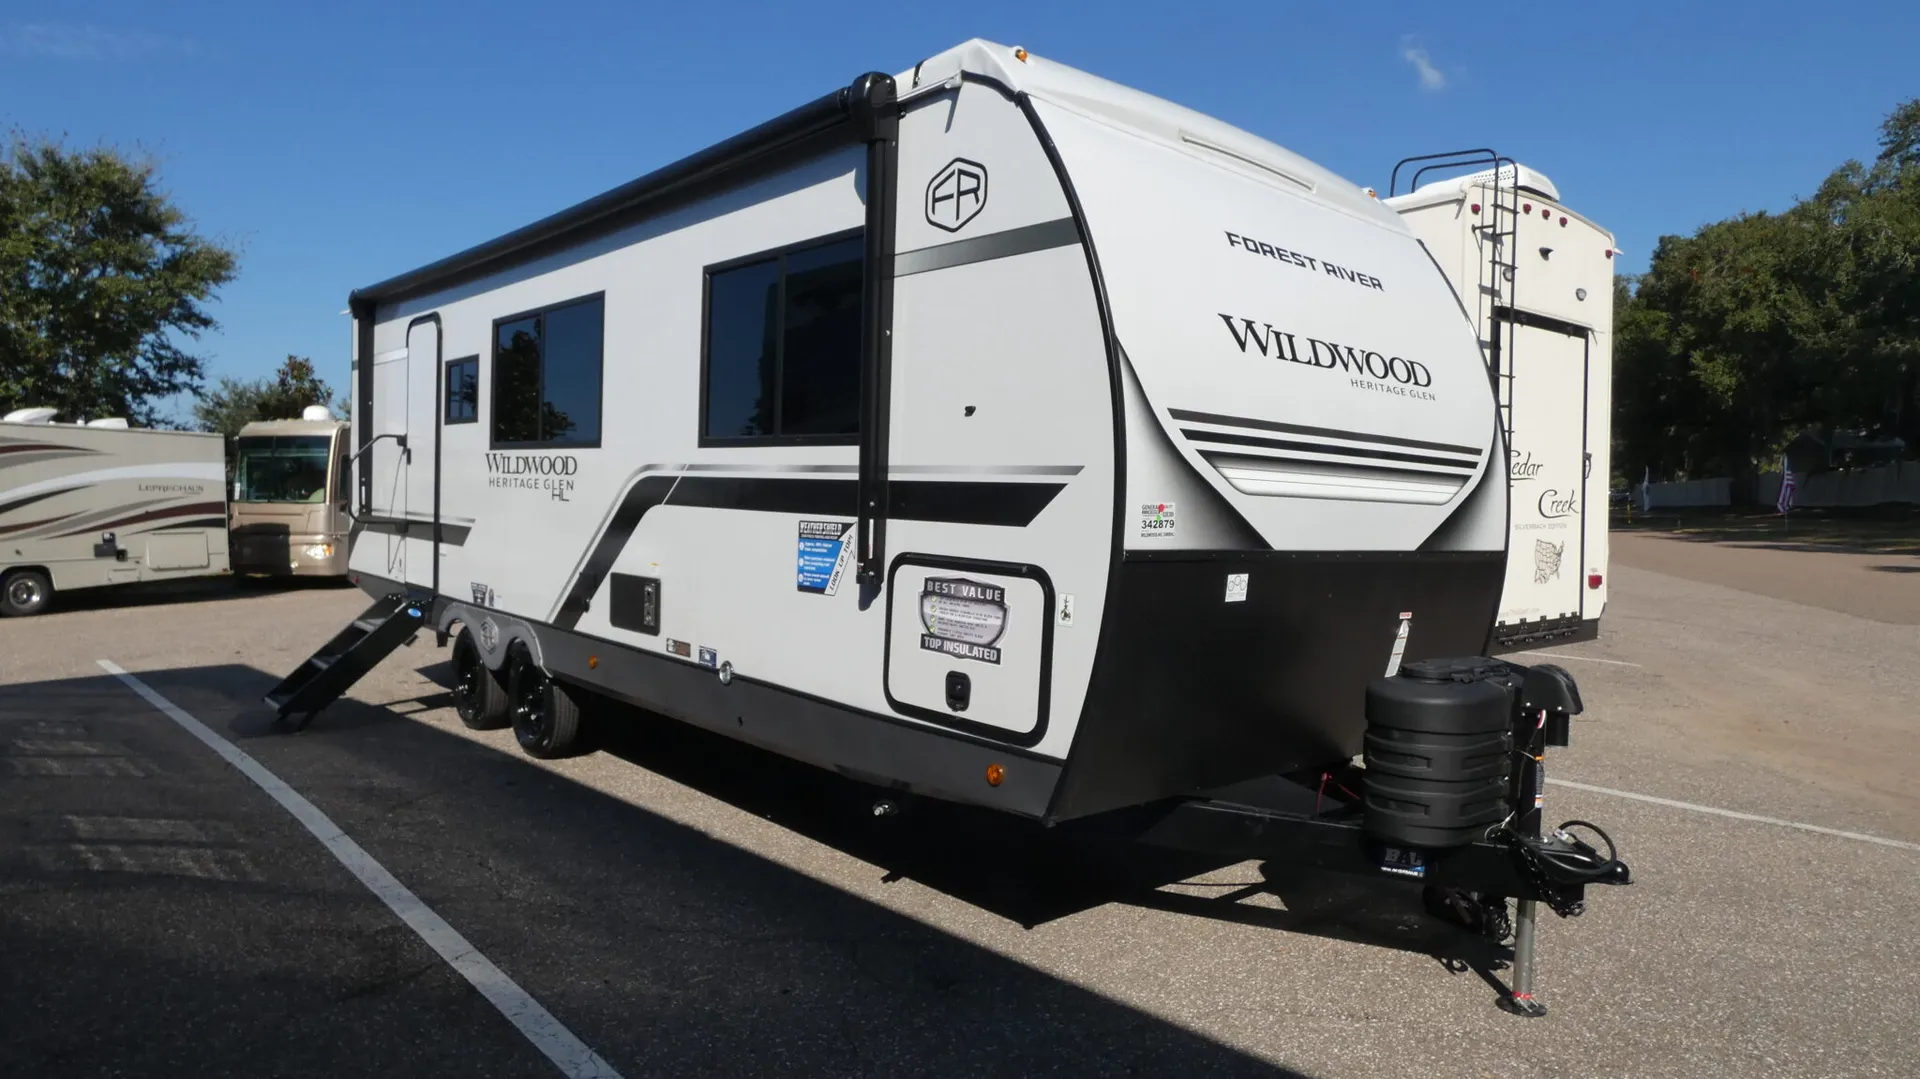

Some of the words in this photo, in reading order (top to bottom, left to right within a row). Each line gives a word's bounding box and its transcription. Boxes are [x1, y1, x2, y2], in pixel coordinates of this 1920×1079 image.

[1225, 231, 1317, 271] FOREST
[1321, 260, 1385, 292] RIVER
[1218, 313, 1432, 388] WILDWOOD
[1351, 378, 1407, 397] HERITAGE
[1409, 389, 1436, 401] GLEN
[485, 452, 578, 476] WILDWOOD
[489, 477, 540, 489] HERITAGE
[543, 479, 574, 490] GLEN
[1538, 489, 1580, 519] Creek
[1141, 520, 1175, 529] 342879
[829, 570, 840, 591] LOOK
[838, 555, 844, 568] UP
[927, 580, 956, 594] BEST
[962, 585, 1001, 601] VALUE
[924, 637, 941, 649] TOP
[943, 641, 998, 661] INSULATED
